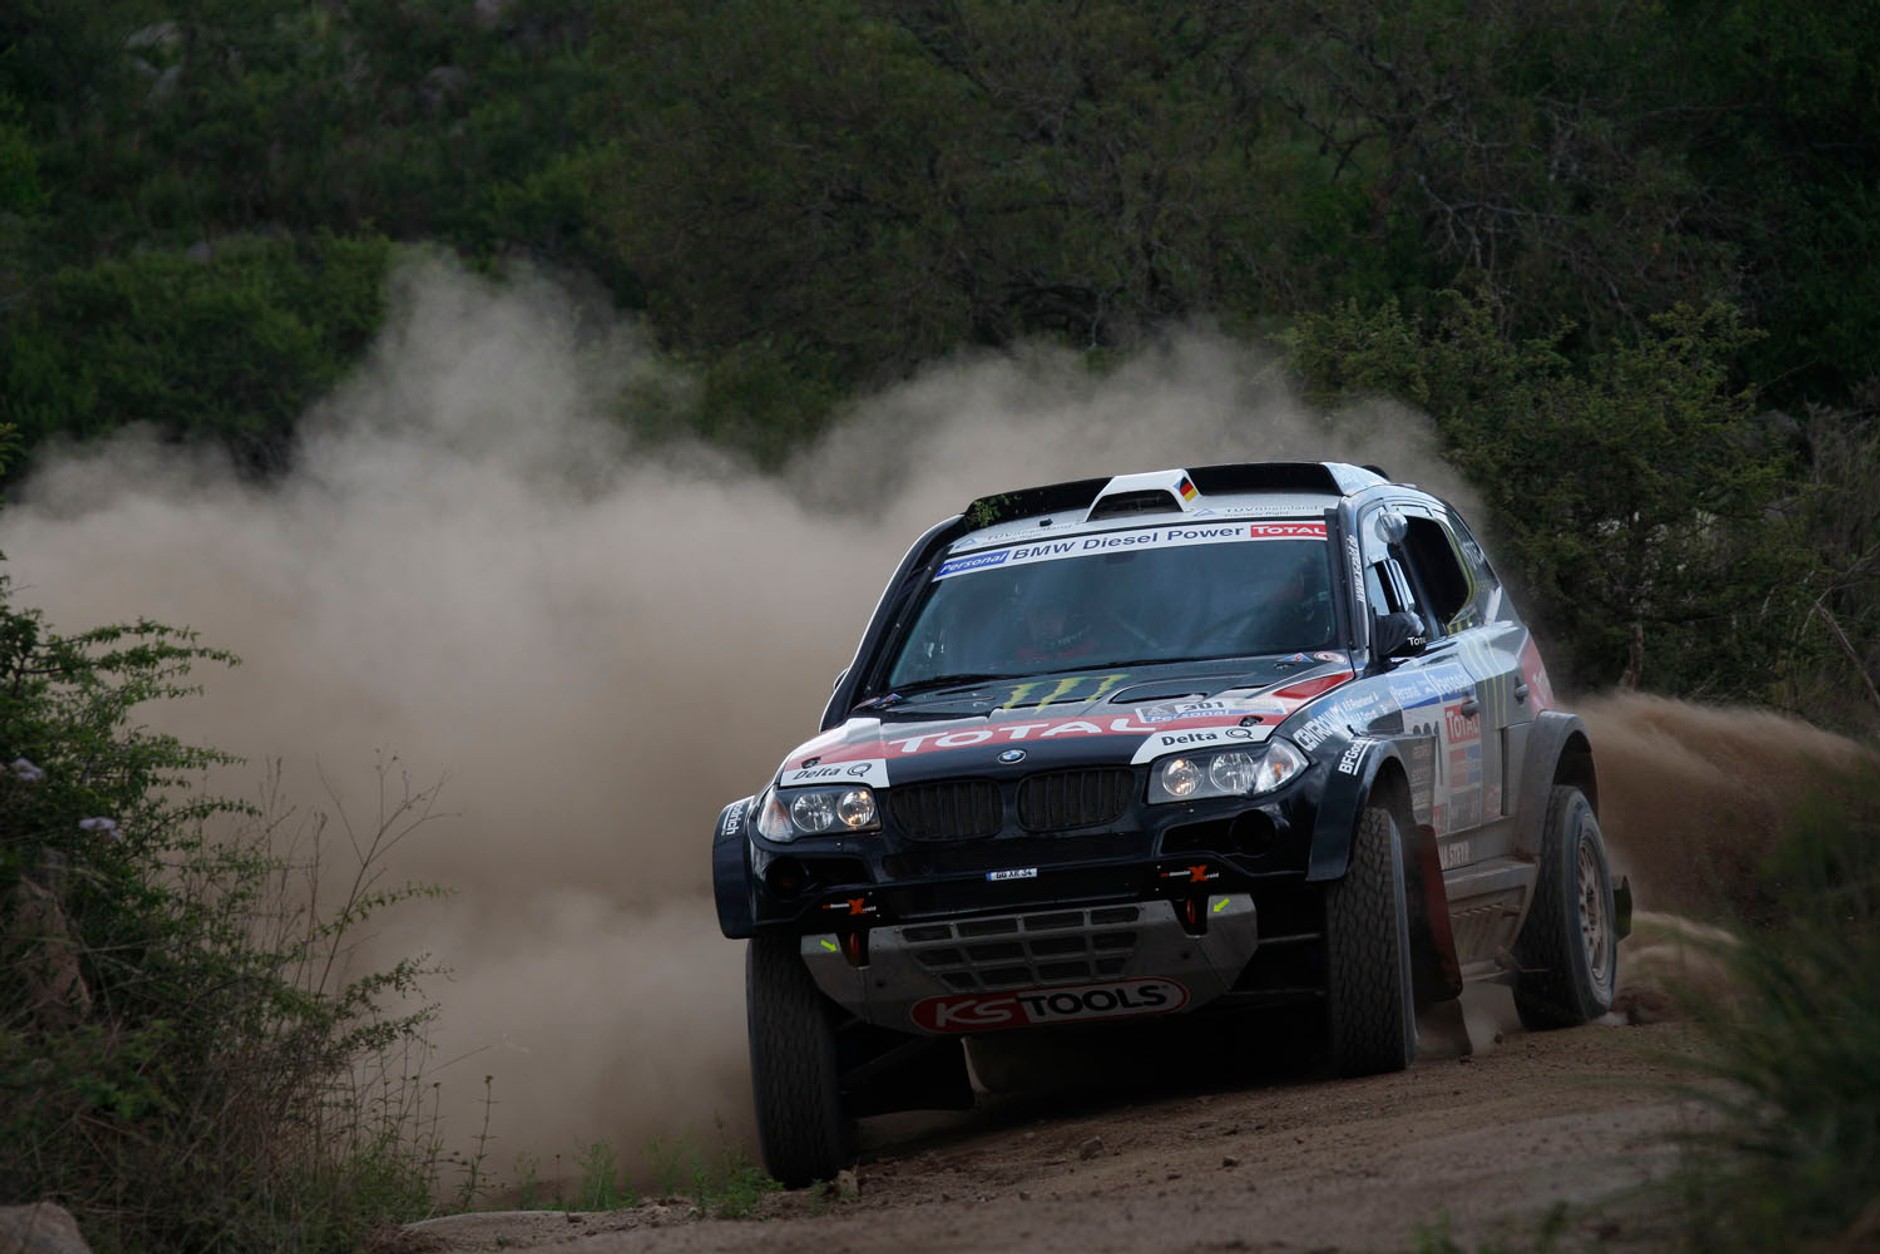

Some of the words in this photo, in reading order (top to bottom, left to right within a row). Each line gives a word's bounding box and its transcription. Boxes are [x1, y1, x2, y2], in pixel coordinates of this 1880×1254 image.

[1252, 524, 1327, 535] TOTAL
[940, 552, 1008, 574] Personal
[1012, 542, 1076, 560] BMW
[1083, 532, 1158, 550] Diesel
[1167, 527, 1245, 541] Power
[1182, 701, 1225, 711] 301
[1150, 709, 1230, 722] Personal
[888, 718, 1157, 753] TOTAL
[1161, 730, 1218, 746] Delta
[793, 766, 841, 781] Delta
[935, 999, 1013, 1028] KS
[1015, 985, 1168, 1017] TOOLS
